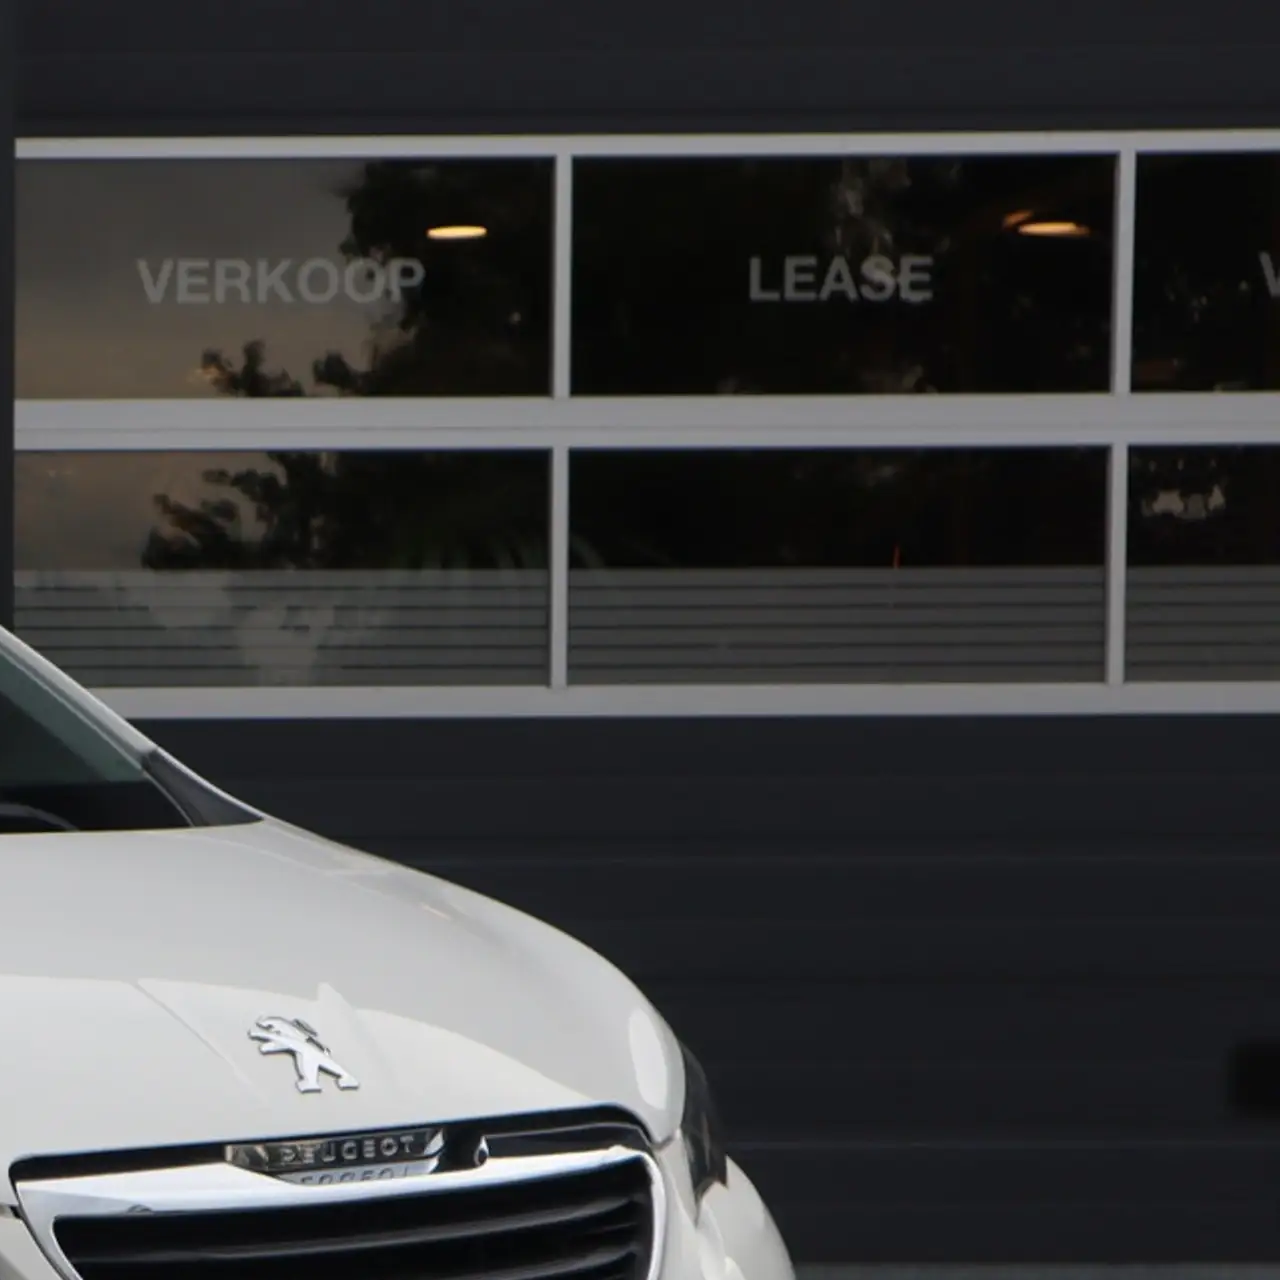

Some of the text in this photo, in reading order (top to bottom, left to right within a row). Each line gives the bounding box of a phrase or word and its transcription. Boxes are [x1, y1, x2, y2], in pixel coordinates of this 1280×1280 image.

[137, 257, 426, 304] VERKOOP
[749, 256, 934, 302] LEASE
[279, 1135, 415, 1165] PEUGEOT
